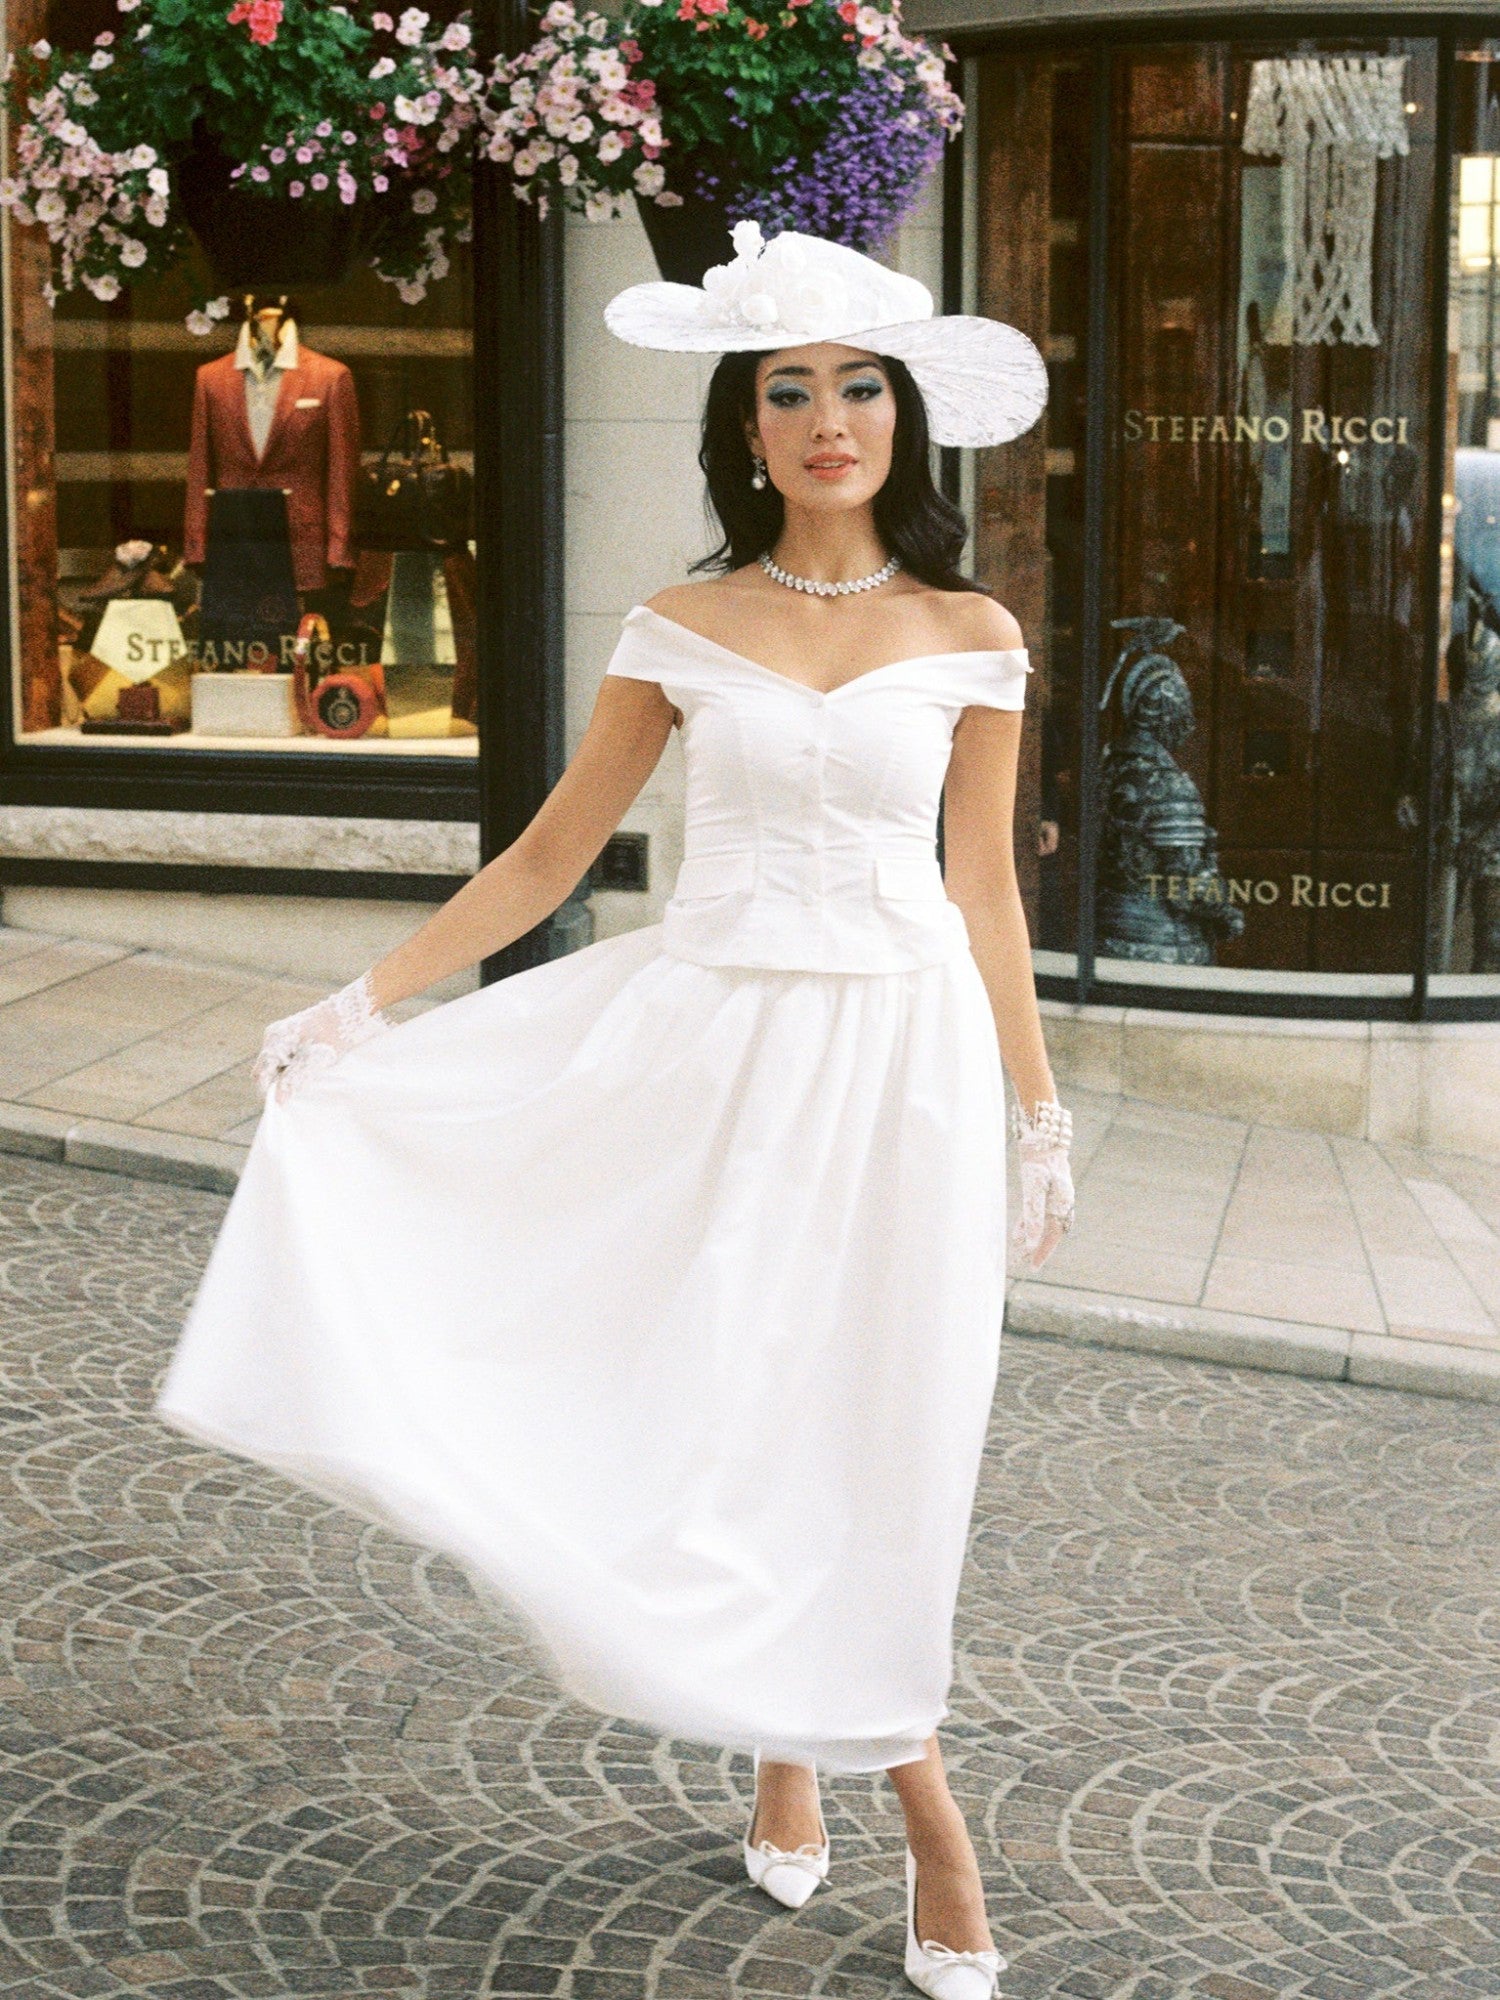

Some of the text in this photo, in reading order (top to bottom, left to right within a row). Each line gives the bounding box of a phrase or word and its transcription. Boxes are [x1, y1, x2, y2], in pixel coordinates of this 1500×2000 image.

[1123, 408, 1409, 445] STEFANO RICCI
[126, 631, 368, 666] STEFANO RICCI
[1291, 873, 1391, 908] RICCI
